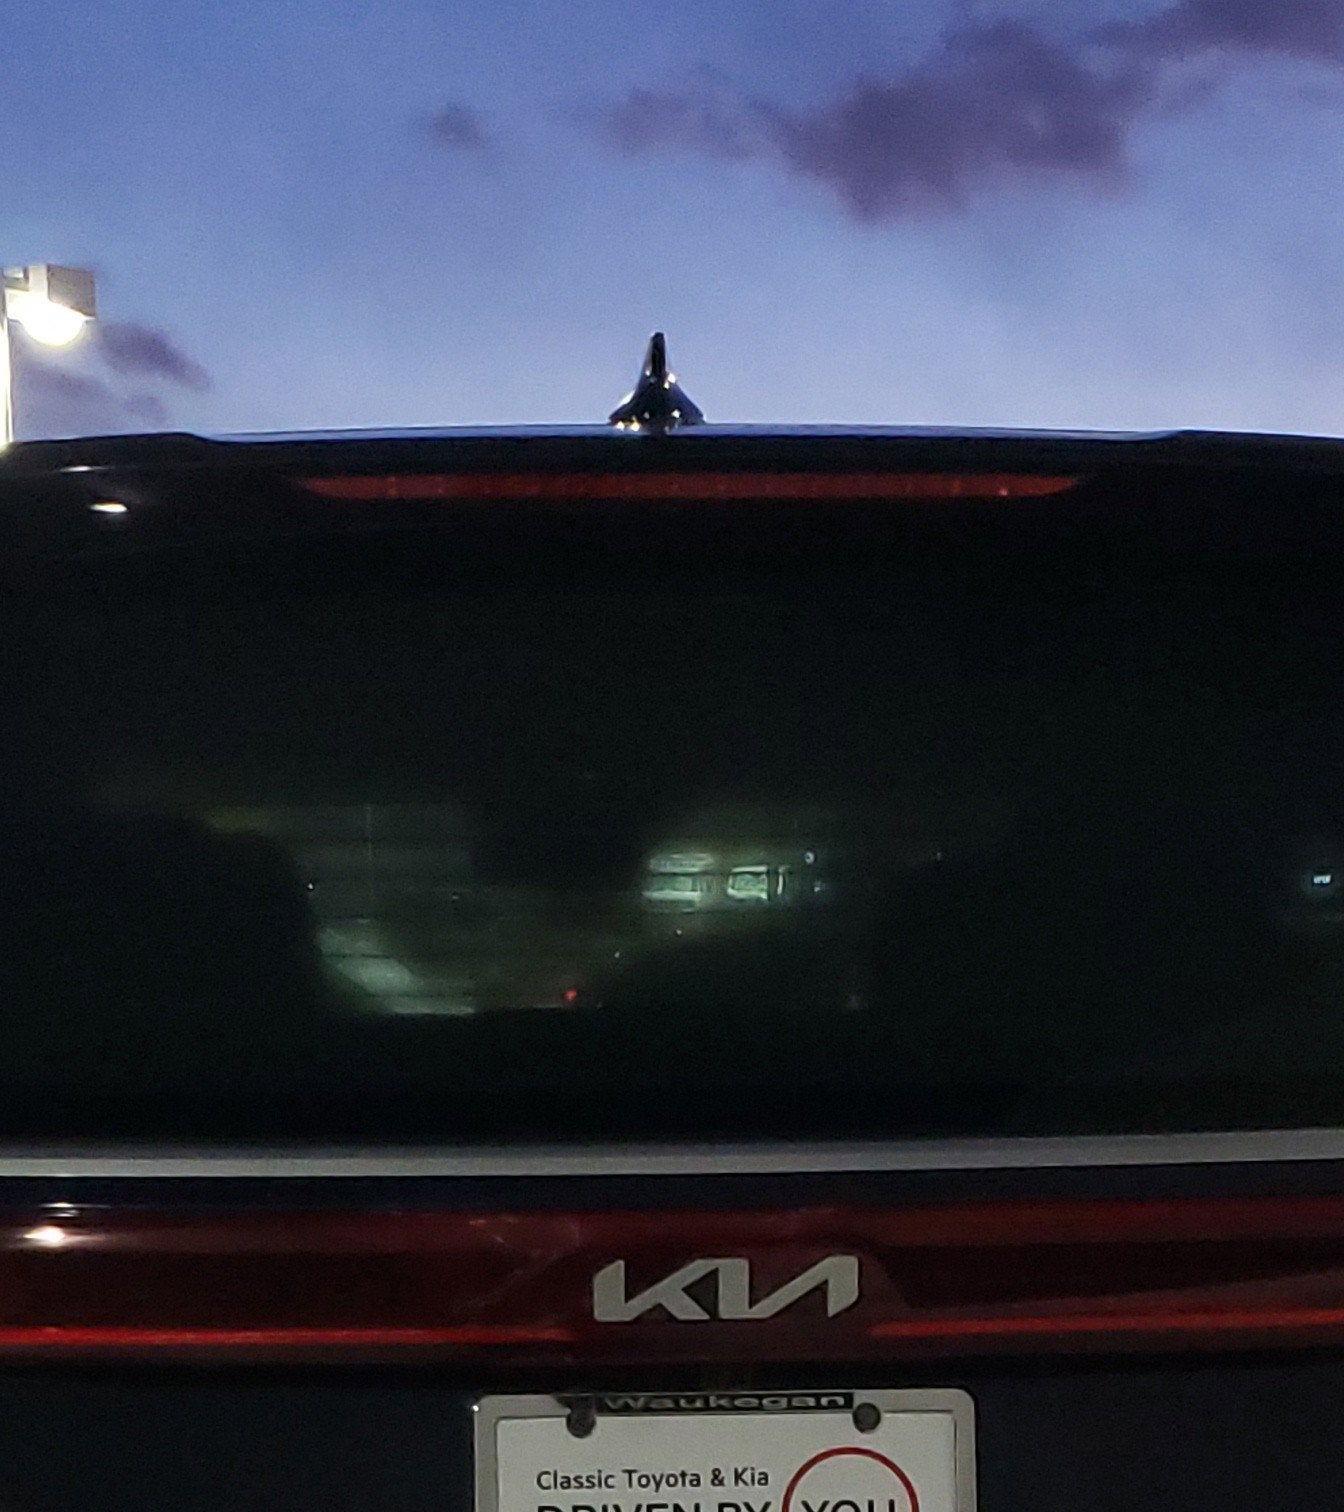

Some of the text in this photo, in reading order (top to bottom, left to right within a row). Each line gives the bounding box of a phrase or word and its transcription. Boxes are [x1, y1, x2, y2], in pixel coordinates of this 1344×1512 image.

[593, 1255, 859, 1322] KIA
[606, 1395, 846, 1411] Waukegan
[536, 1467, 769, 1493] Classic Toyota & Kia
